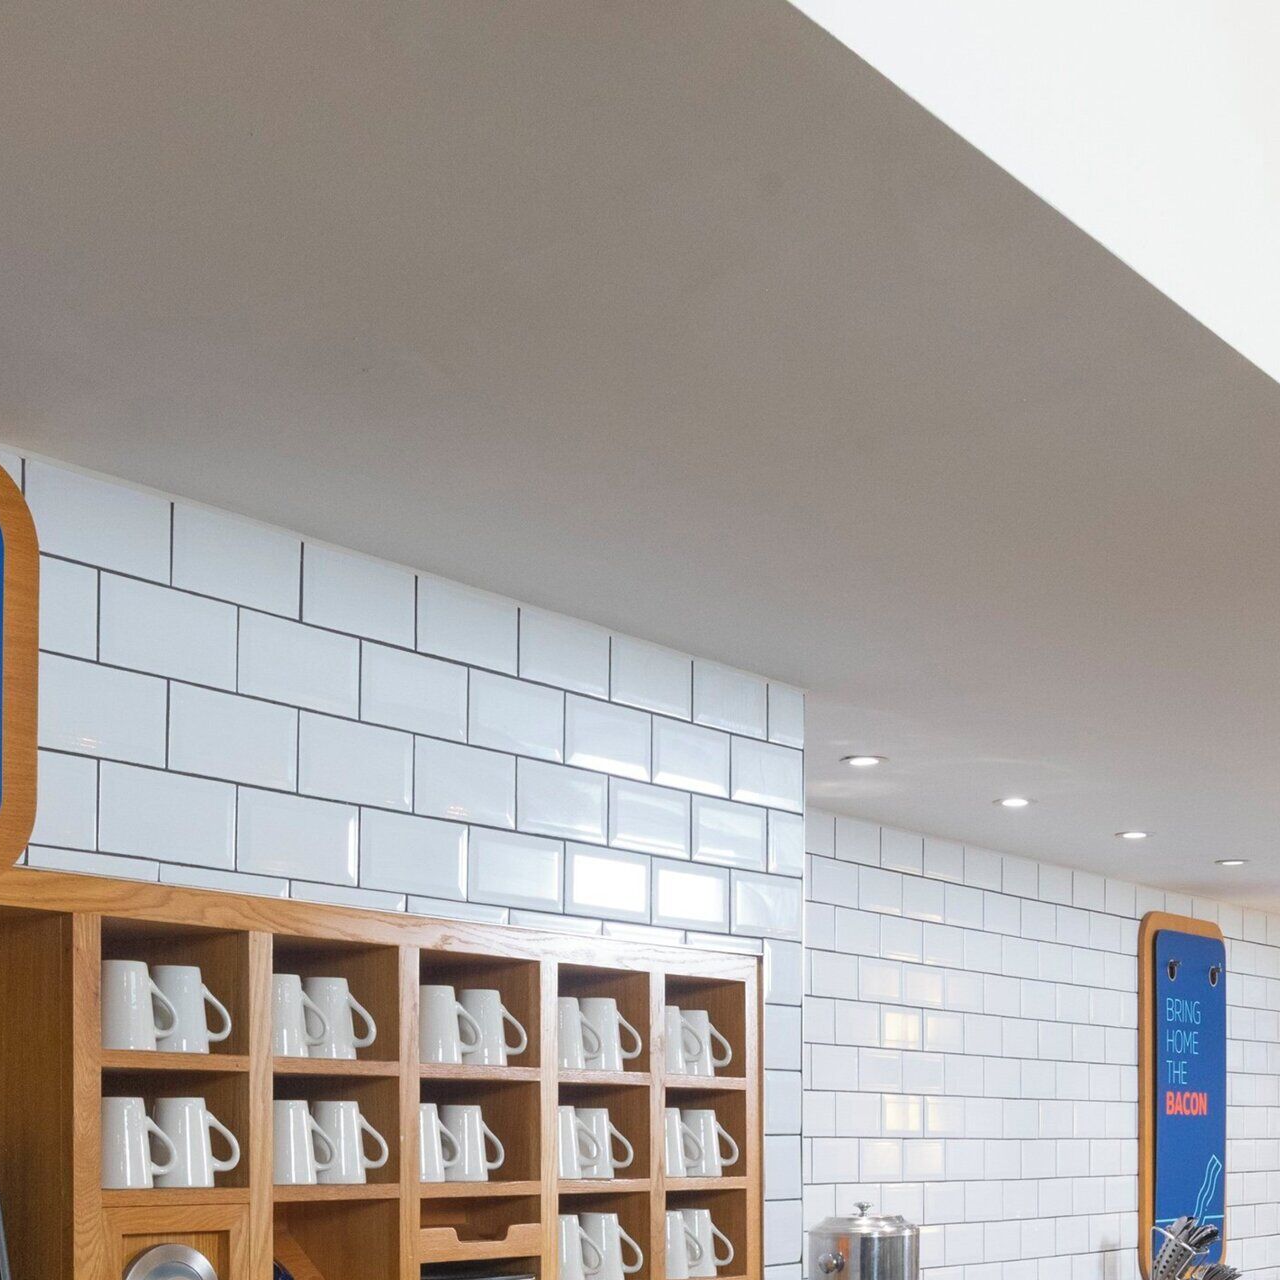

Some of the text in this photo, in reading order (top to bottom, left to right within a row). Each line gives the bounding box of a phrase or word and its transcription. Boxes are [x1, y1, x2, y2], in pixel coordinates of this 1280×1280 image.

[1166, 997, 1201, 1025] BRING
[1166, 1029, 1199, 1055] HOME
[1166, 1060, 1188, 1085] THE
[1166, 1090, 1208, 1115] BACON
